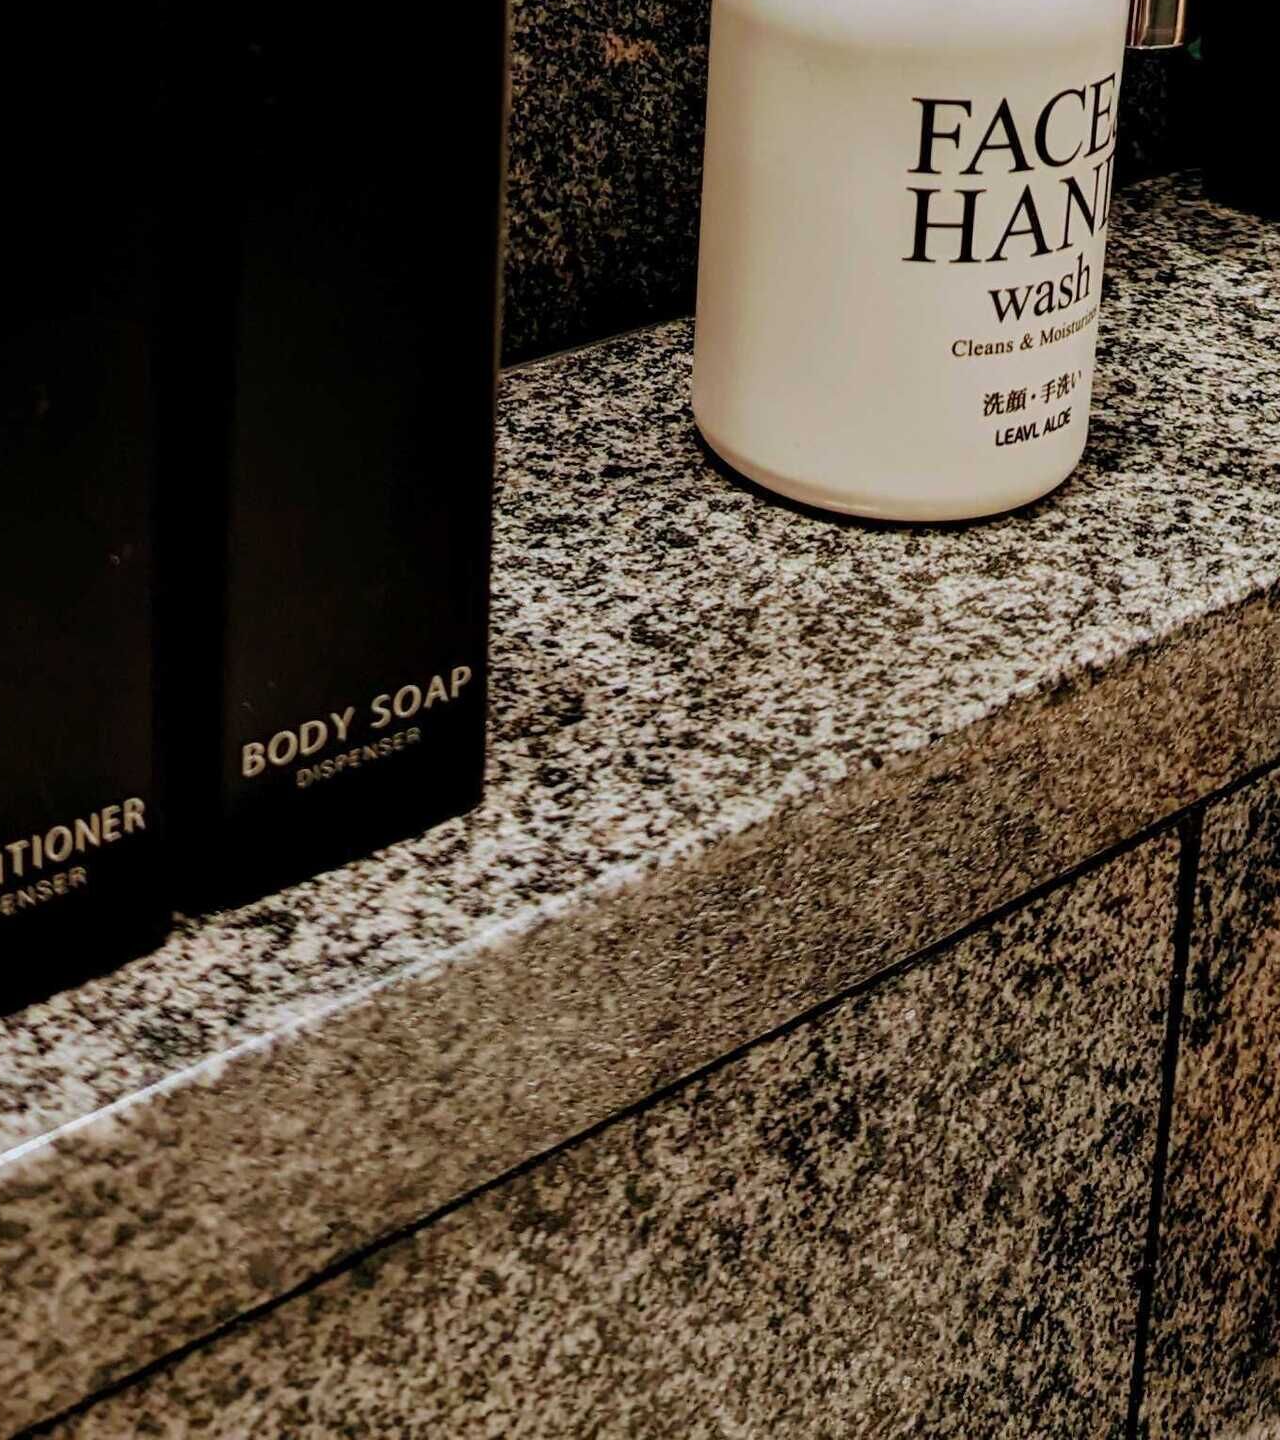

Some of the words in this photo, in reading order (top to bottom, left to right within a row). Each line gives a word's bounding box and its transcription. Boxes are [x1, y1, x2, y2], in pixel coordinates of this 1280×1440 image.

[907, 72, 1116, 175] FACE
[988, 252, 1091, 324] wash
[951, 339, 1015, 358] Cleans
[1019, 333, 1034, 351] &
[241, 705, 356, 779] BODY
[370, 665, 473, 729] SOAP
[295, 726, 421, 789] DISPENSER
